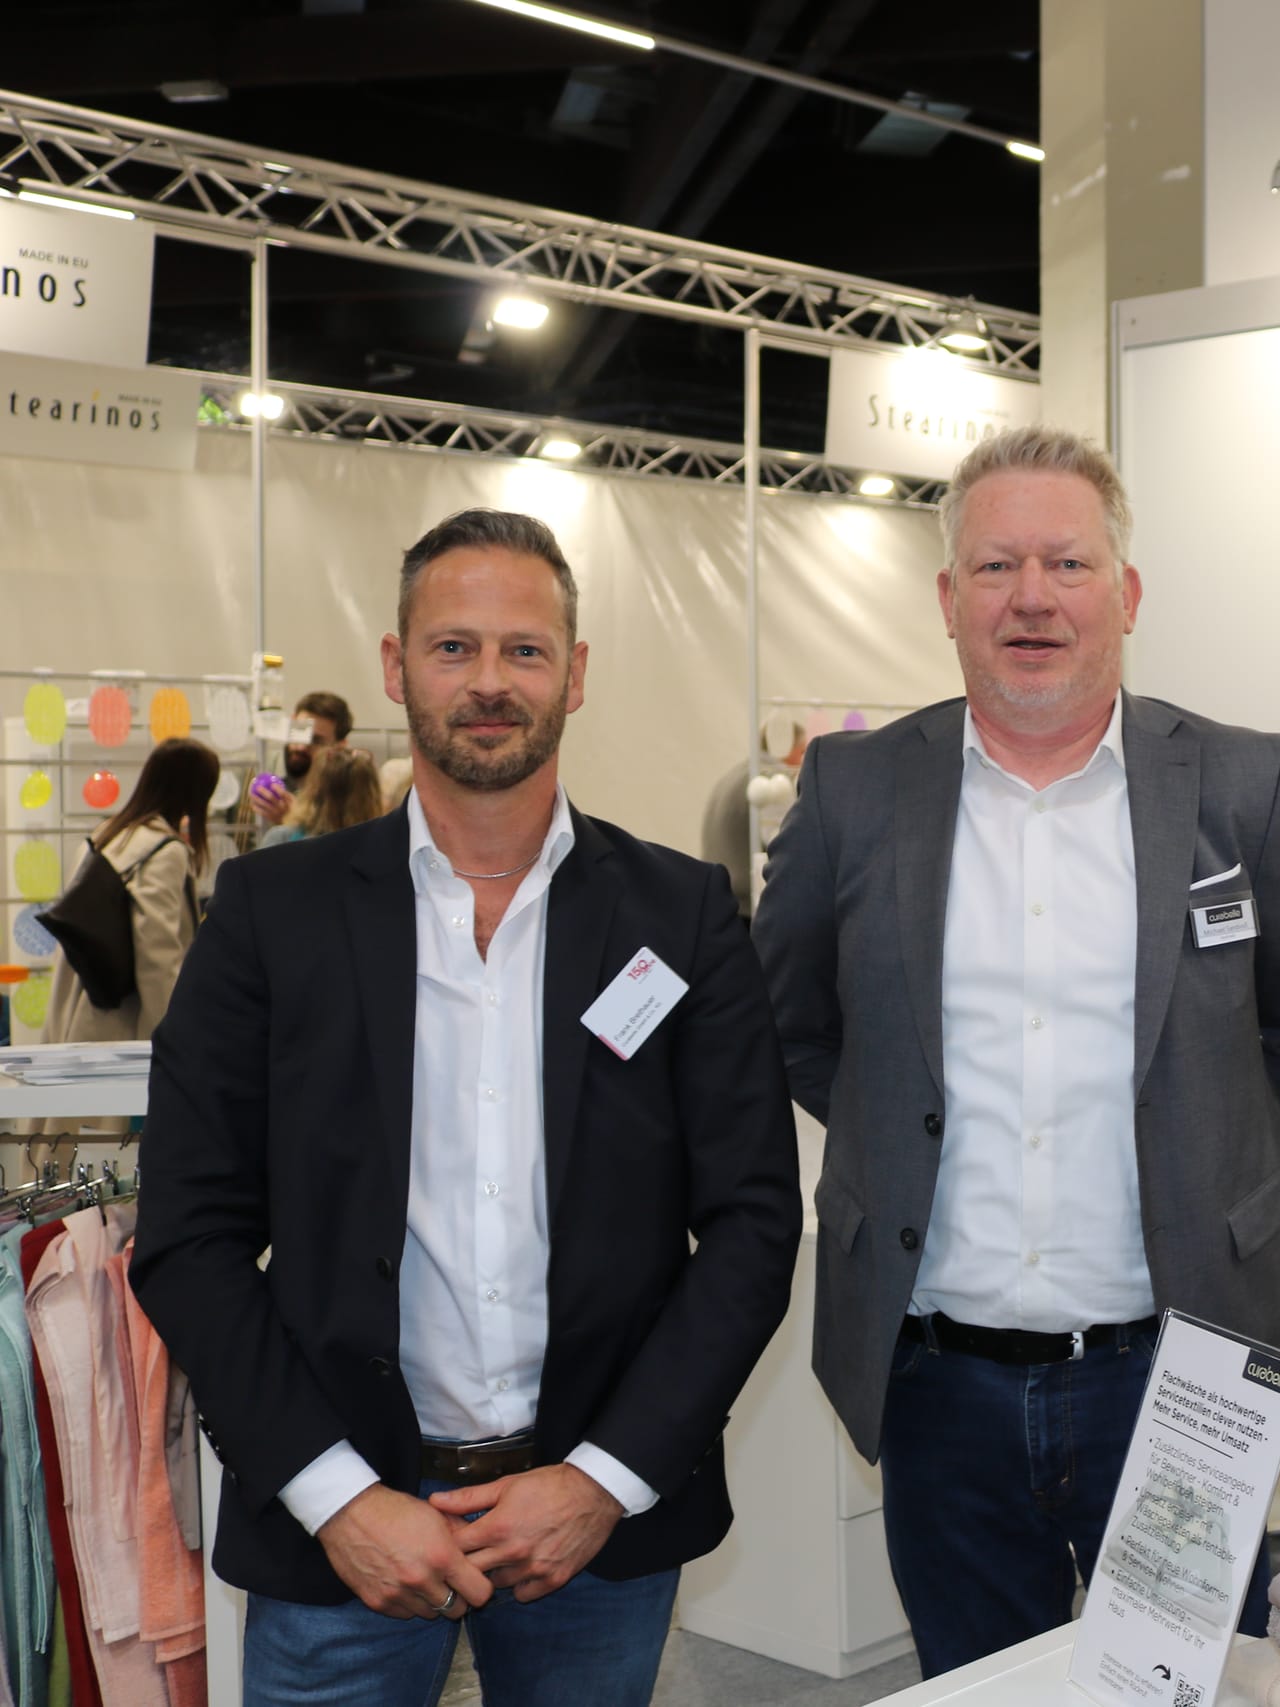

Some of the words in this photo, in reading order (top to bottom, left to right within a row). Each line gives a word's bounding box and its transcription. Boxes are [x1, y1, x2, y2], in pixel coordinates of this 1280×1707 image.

[19, 248, 53, 263] MADE
[57, 254, 69, 265] IN
[73, 256, 88, 268] EU
[868, 394, 1008, 441] Stearino
[1156, 1384, 1213, 1418] Servicetextilien
[1211, 1409, 1236, 1429] clever
[1235, 1421, 1264, 1442] nutzen
[1161, 1369, 1207, 1399] Flachwäsche
[1206, 1389, 1218, 1404] als
[1217, 1395, 1267, 1426] hochwertige
[1152, 1399, 1170, 1416] Mehr
[1169, 1407, 1200, 1431] Service,
[1199, 1421, 1220, 1439] mehr
[1220, 1431, 1250, 1453] Umsatz
[1152, 1437, 1198, 1467] Zusätzliches
[1195, 1458, 1256, 1497] Serviceangebot
[1106, 1599, 1126, 1618] Haus
